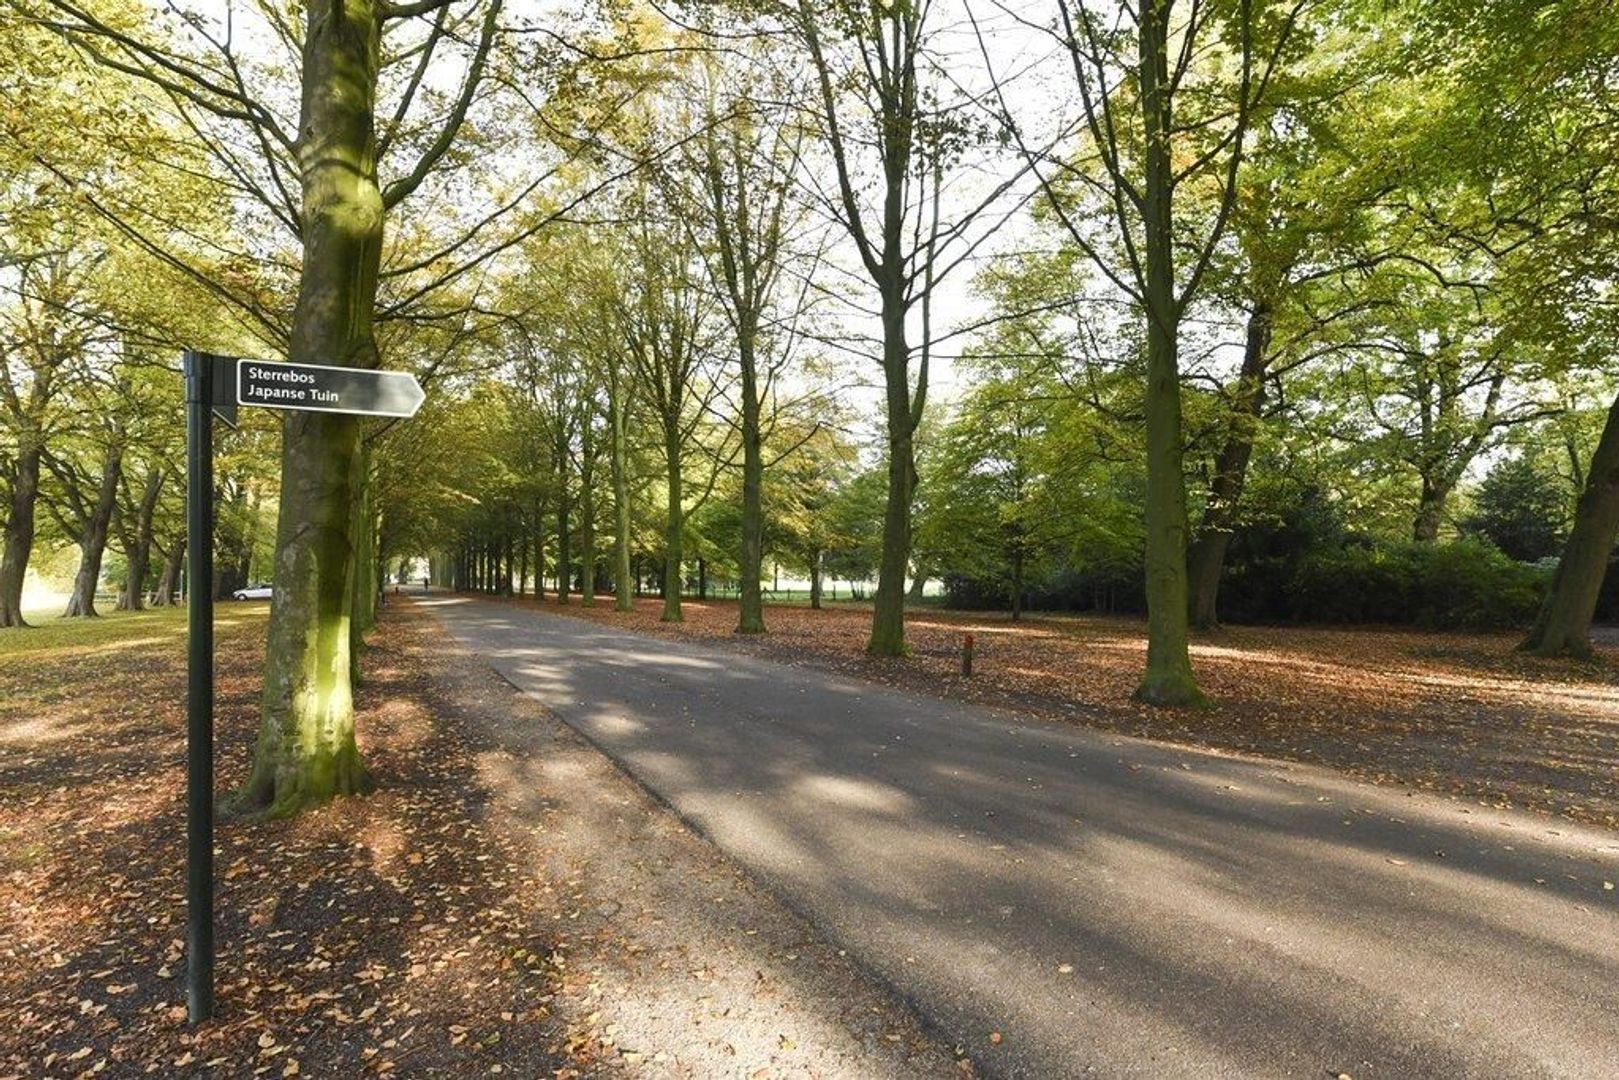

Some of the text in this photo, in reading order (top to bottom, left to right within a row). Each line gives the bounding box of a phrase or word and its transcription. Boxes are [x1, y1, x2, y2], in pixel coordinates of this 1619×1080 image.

[249, 367, 315, 384] Sterrebos
[248, 384, 339, 402] Japanse Tuin
